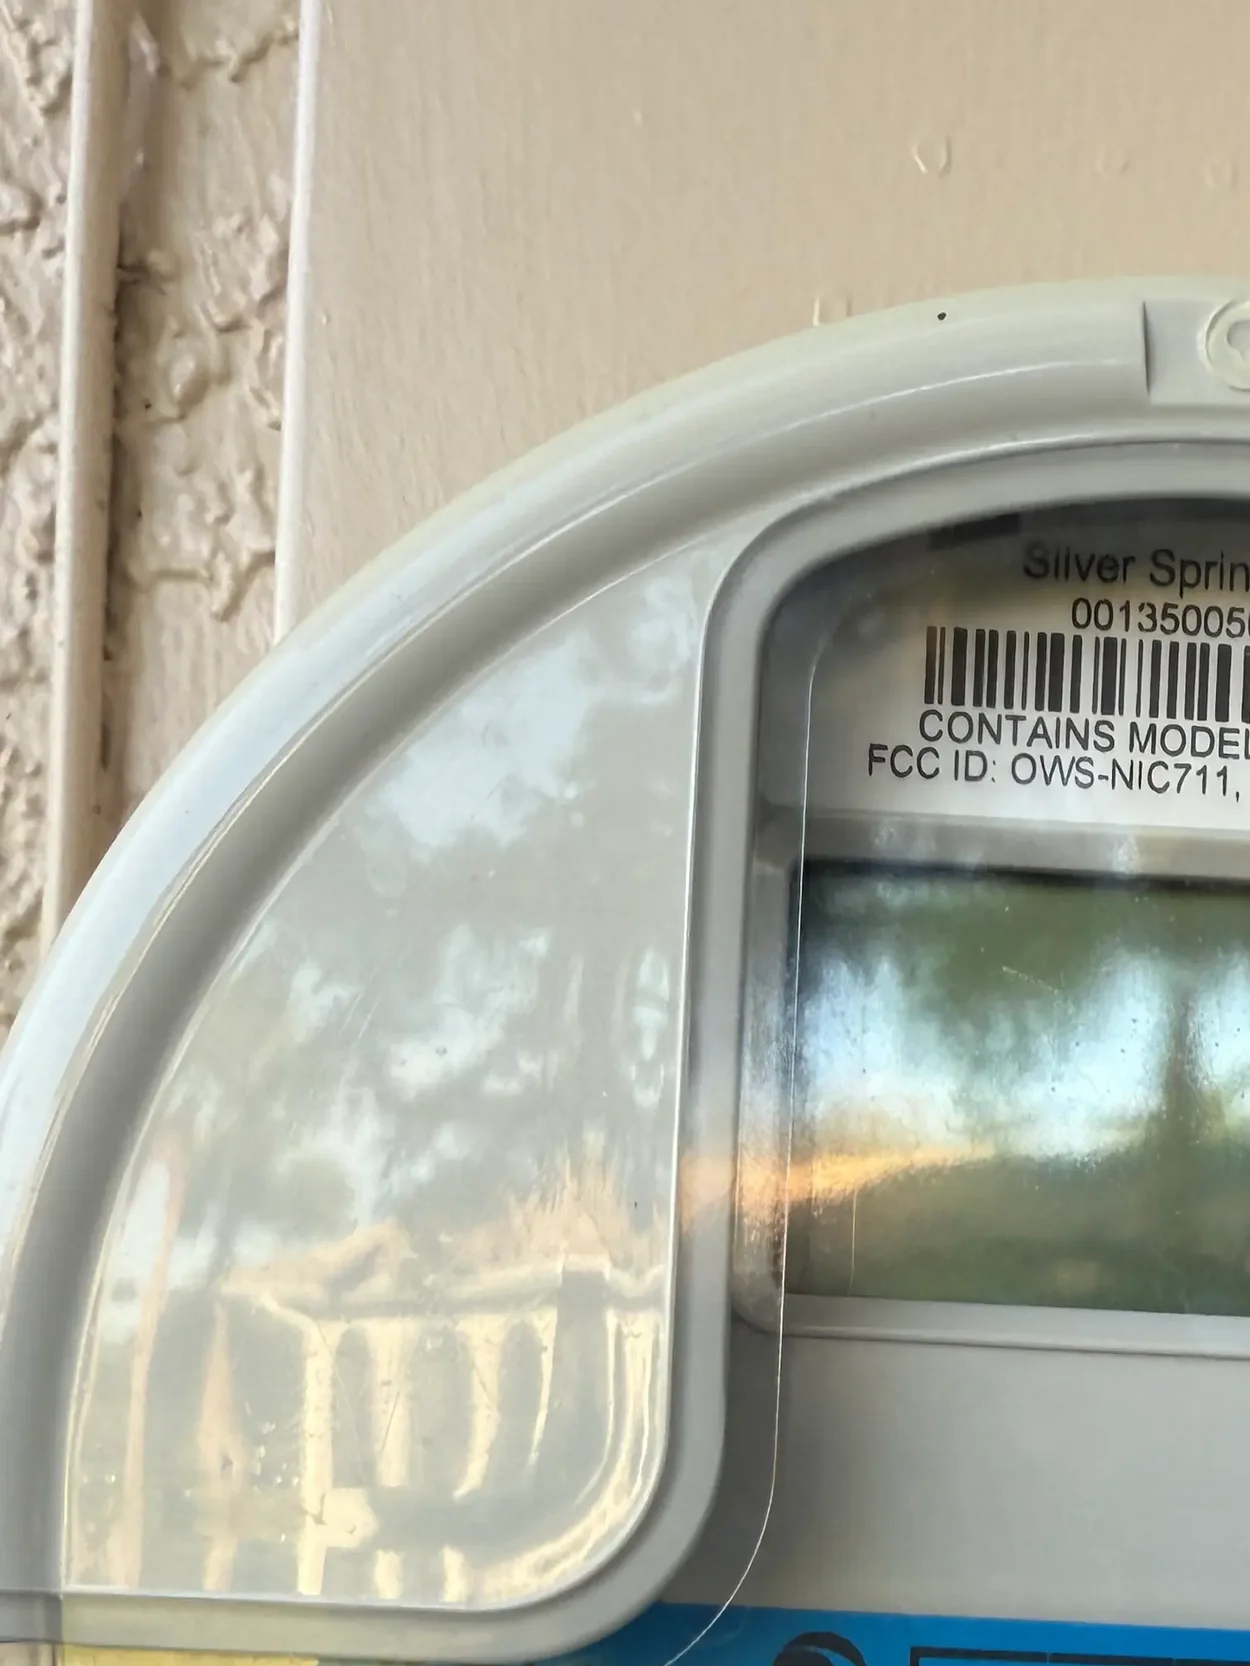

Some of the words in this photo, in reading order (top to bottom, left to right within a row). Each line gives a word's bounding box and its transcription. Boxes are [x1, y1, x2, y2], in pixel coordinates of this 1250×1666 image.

[1022, 540, 1136, 582] Silver
[917, 708, 1116, 754] CONTAINS
[866, 743, 943, 780] FCC
[951, 752, 997, 785] ID:
[1010, 756, 1244, 803] OWS-NIC711,
